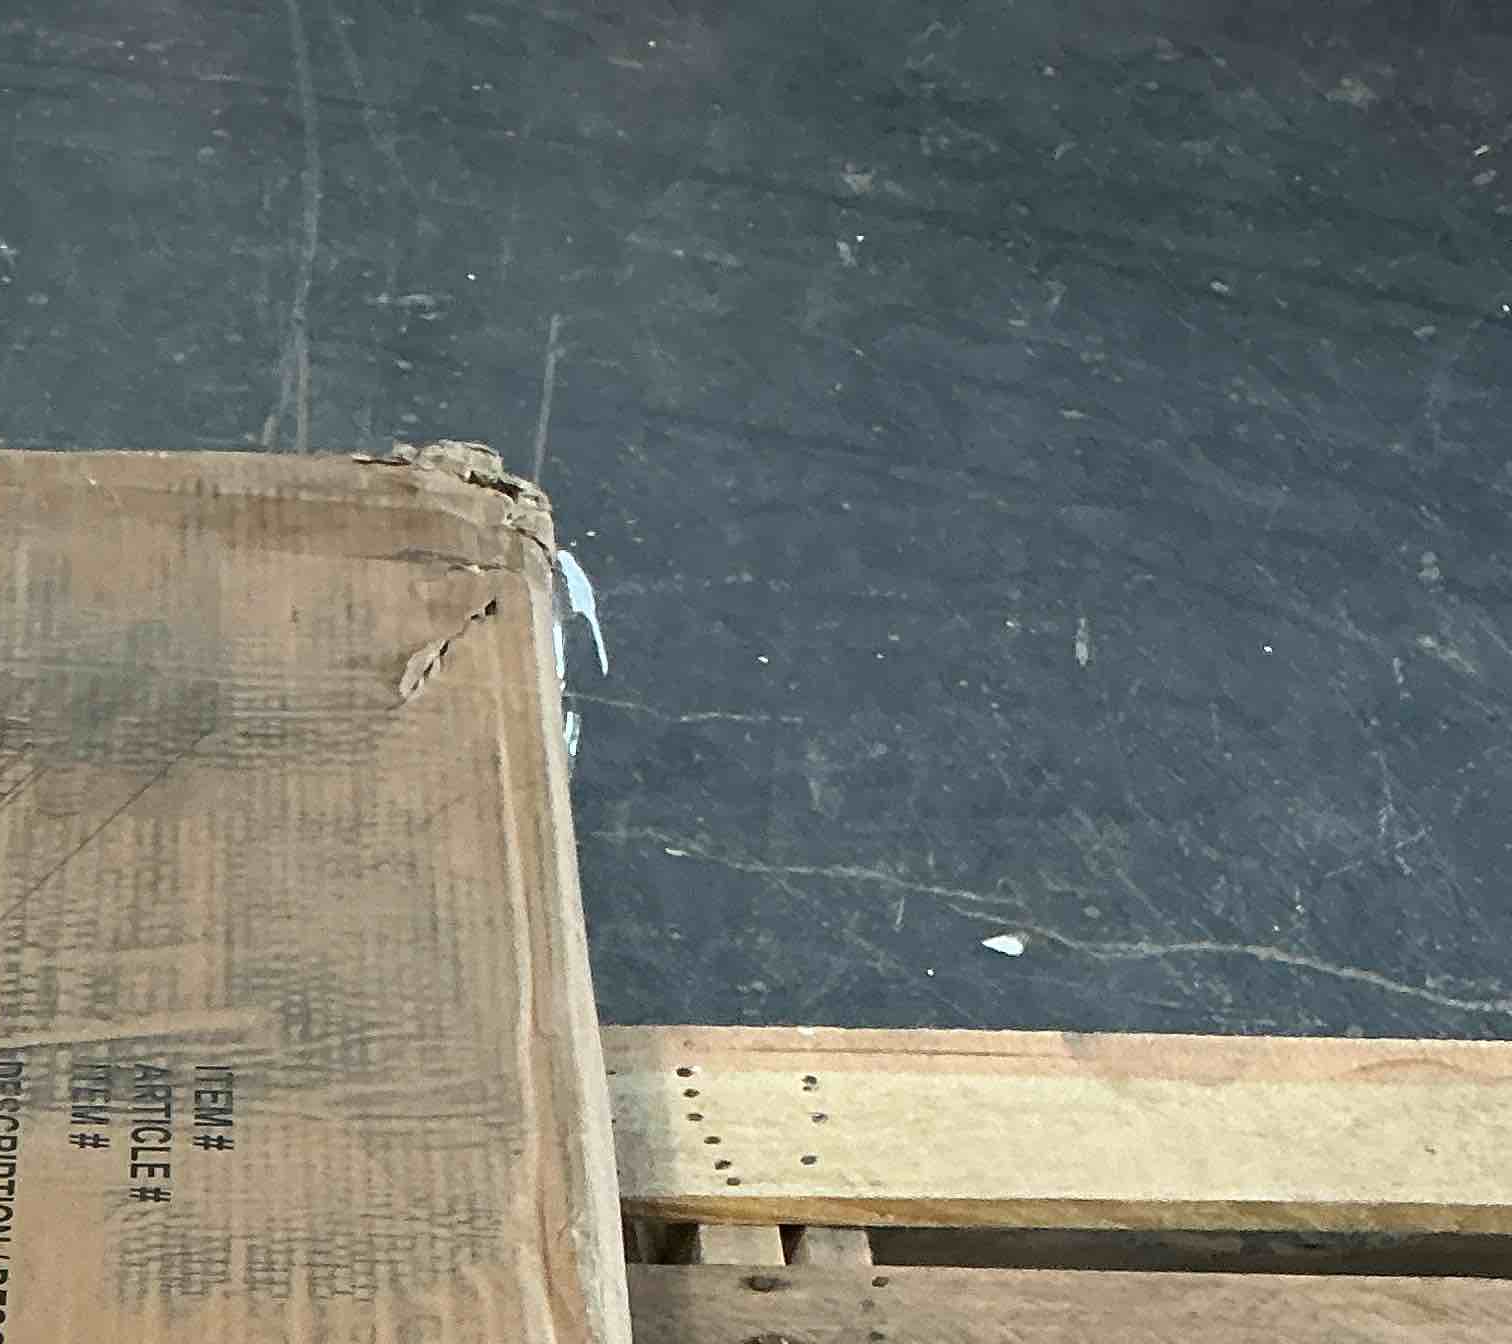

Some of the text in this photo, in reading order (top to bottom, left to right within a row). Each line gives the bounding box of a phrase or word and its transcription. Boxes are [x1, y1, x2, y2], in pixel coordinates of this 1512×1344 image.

[71, 1064, 111, 1125] ITEM
[130, 1063, 172, 1178] ARTICLE
[194, 1066, 233, 1126] ITEM
